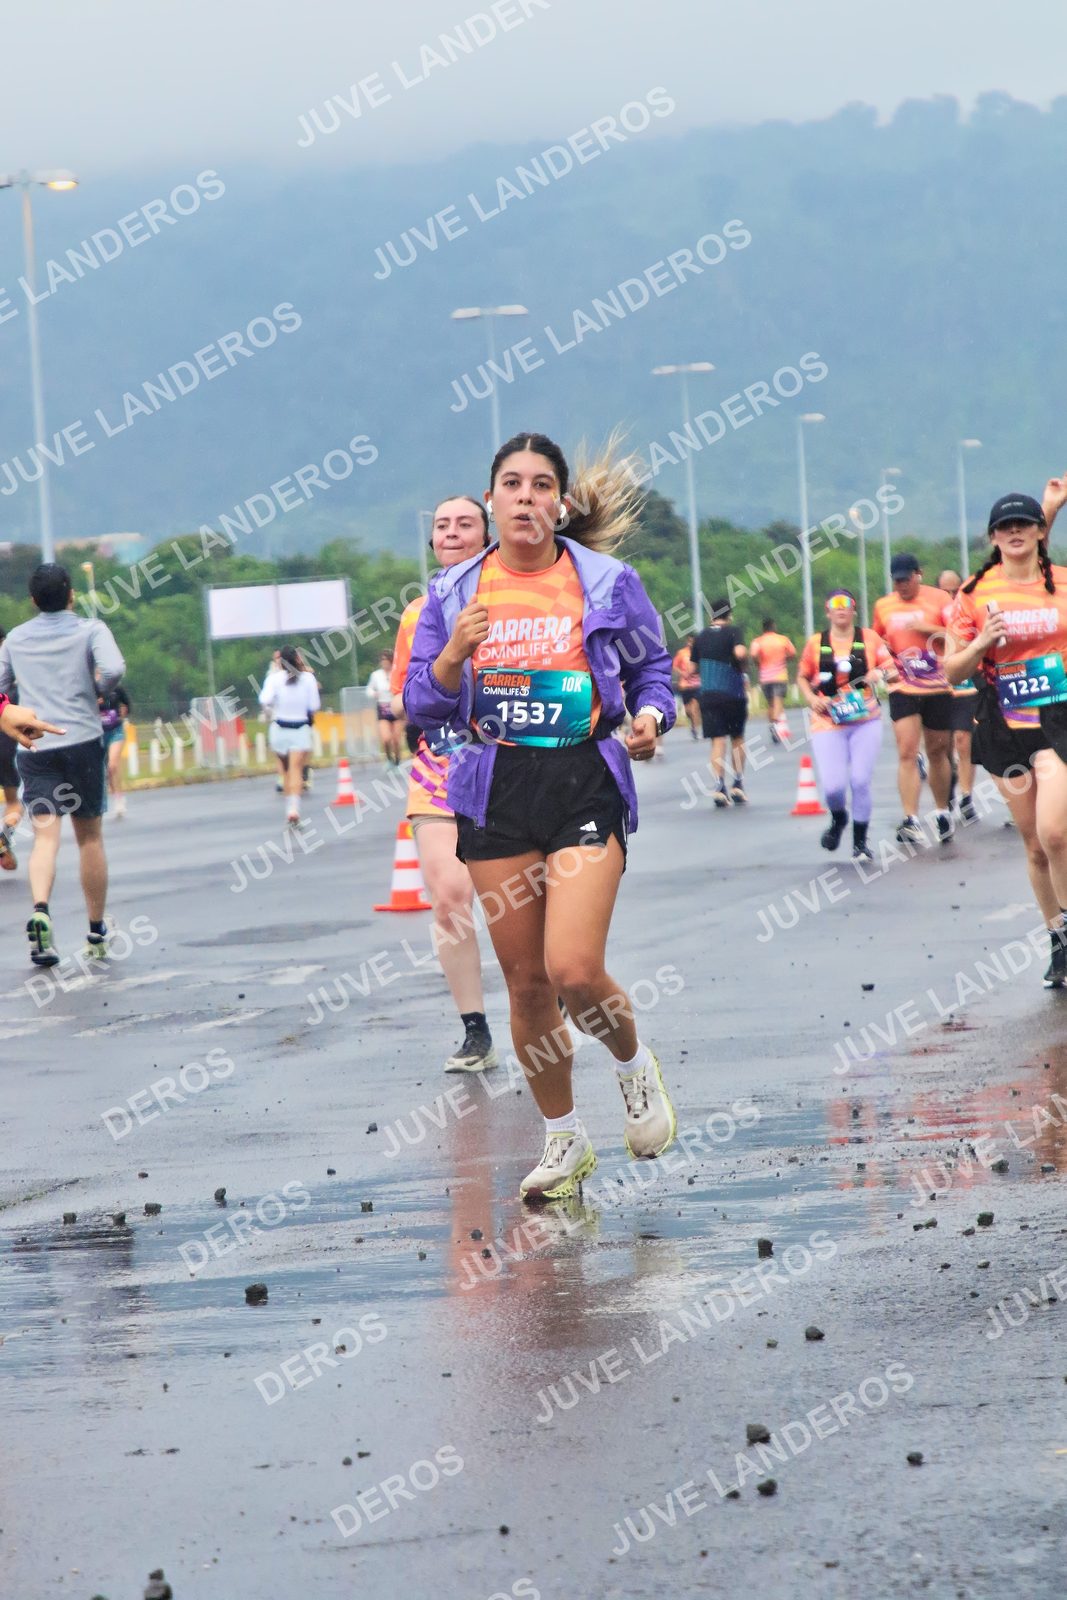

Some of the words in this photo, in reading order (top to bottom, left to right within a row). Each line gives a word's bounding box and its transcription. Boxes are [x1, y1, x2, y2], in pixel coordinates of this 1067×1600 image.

[478, 641, 549, 660] OMNILIFE
[483, 673, 531, 686] CARRERA
[561, 676, 582, 693] 10K
[1008, 675, 1051, 696] 1222
[482, 686, 519, 696] OMNILIFE
[496, 700, 563, 725] 1537
